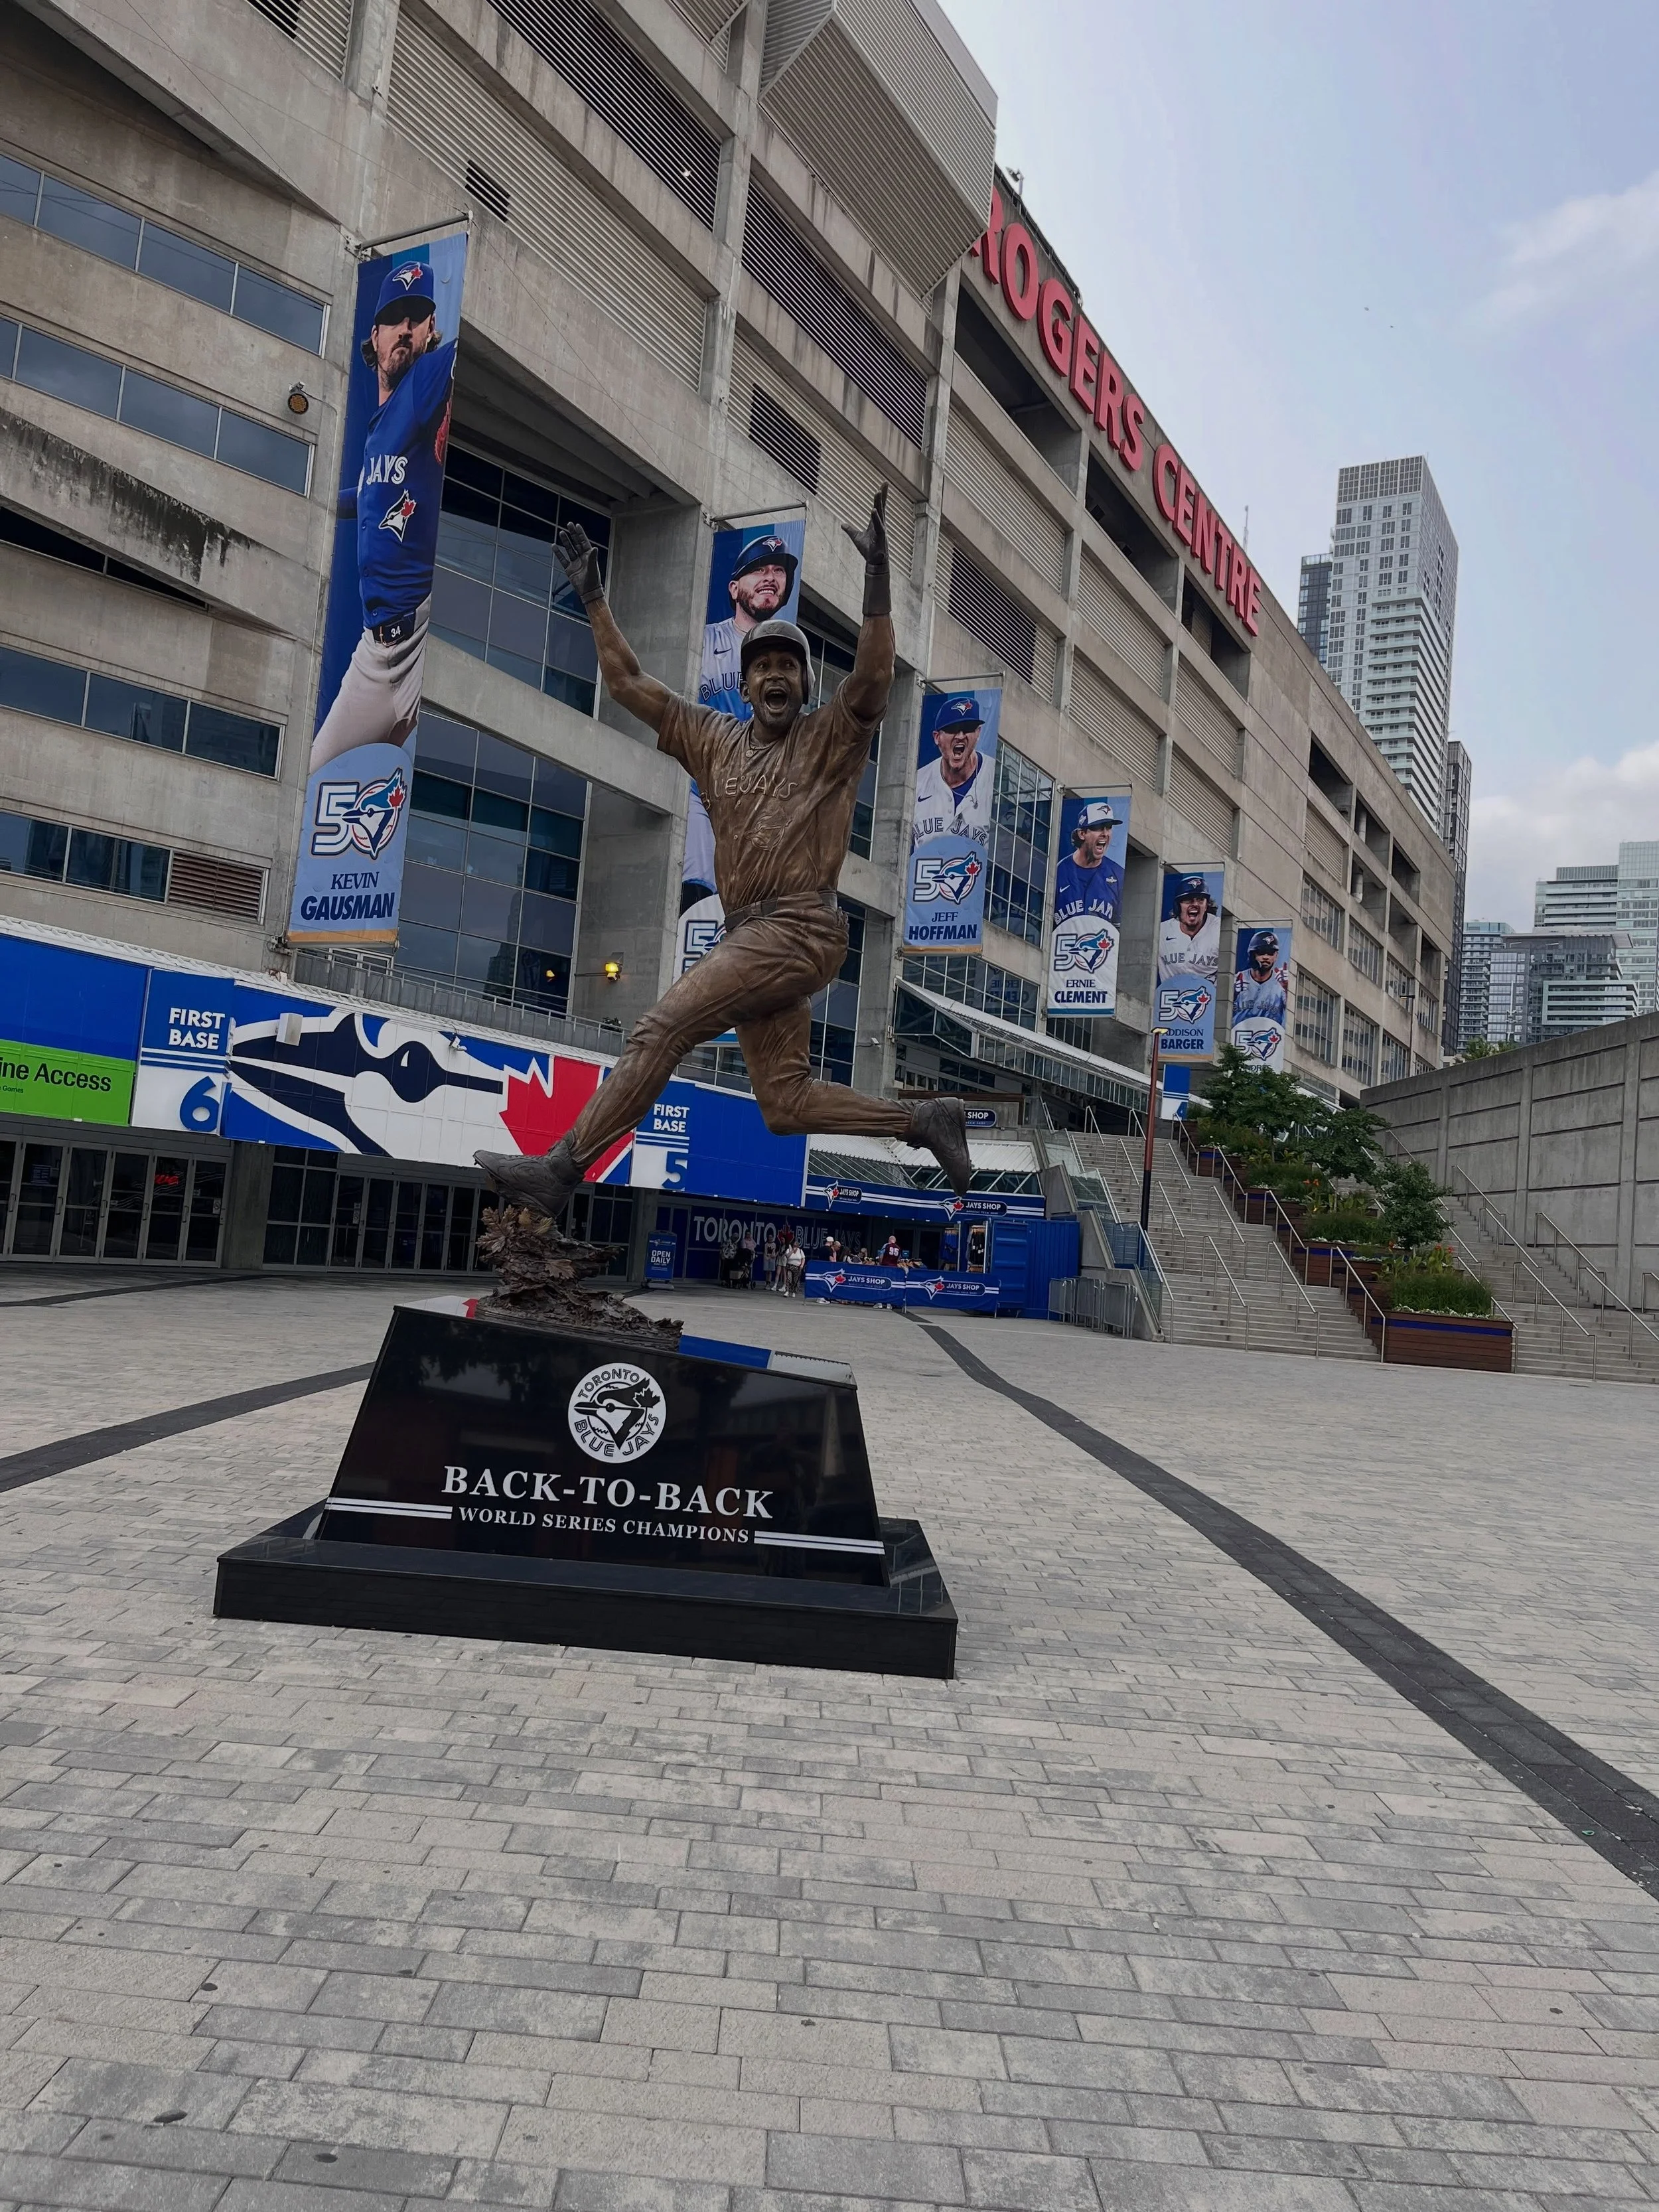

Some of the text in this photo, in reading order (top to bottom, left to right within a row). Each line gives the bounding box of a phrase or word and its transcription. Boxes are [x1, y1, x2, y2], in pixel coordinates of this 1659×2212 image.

[366, 454, 408, 484] JAYS
[1153, 443, 1262, 637] CENTRE
[391, 626, 401, 638] 34
[331, 871, 380, 890] KEVIN
[301, 892, 396, 921] GAUSMAN
[931, 911, 959, 922] JEFF
[1054, 899, 1084, 925] BLUE
[908, 924, 977, 940] HOFFMAN
[1189, 954, 1219, 966] JAYS
[1066, 979, 1096, 988] ERNIE
[1054, 990, 1108, 1003] CLEMENT
[169, 1007, 226, 1029] FIRST
[168, 1028, 220, 1050] BASE
[1161, 1039, 1204, 1050] BARGER
[34, 1063, 111, 1092] Access
[179, 1075, 220, 1132] 6
[653, 1103, 690, 1118] FIRST
[653, 1118, 687, 1133] BASE
[662, 1150, 688, 1191] 5
[693, 1215, 776, 1245] TORONTO
[796, 1225, 828, 1250] BLUE
[578, 1368, 640, 1398] TORONTO
[574, 1413, 659, 1457] BLUE JAYS
[441, 1465, 774, 1519] BACK-TO-BACK
[459, 1507, 749, 1543] WORLD SERIES CHAMPIONS
